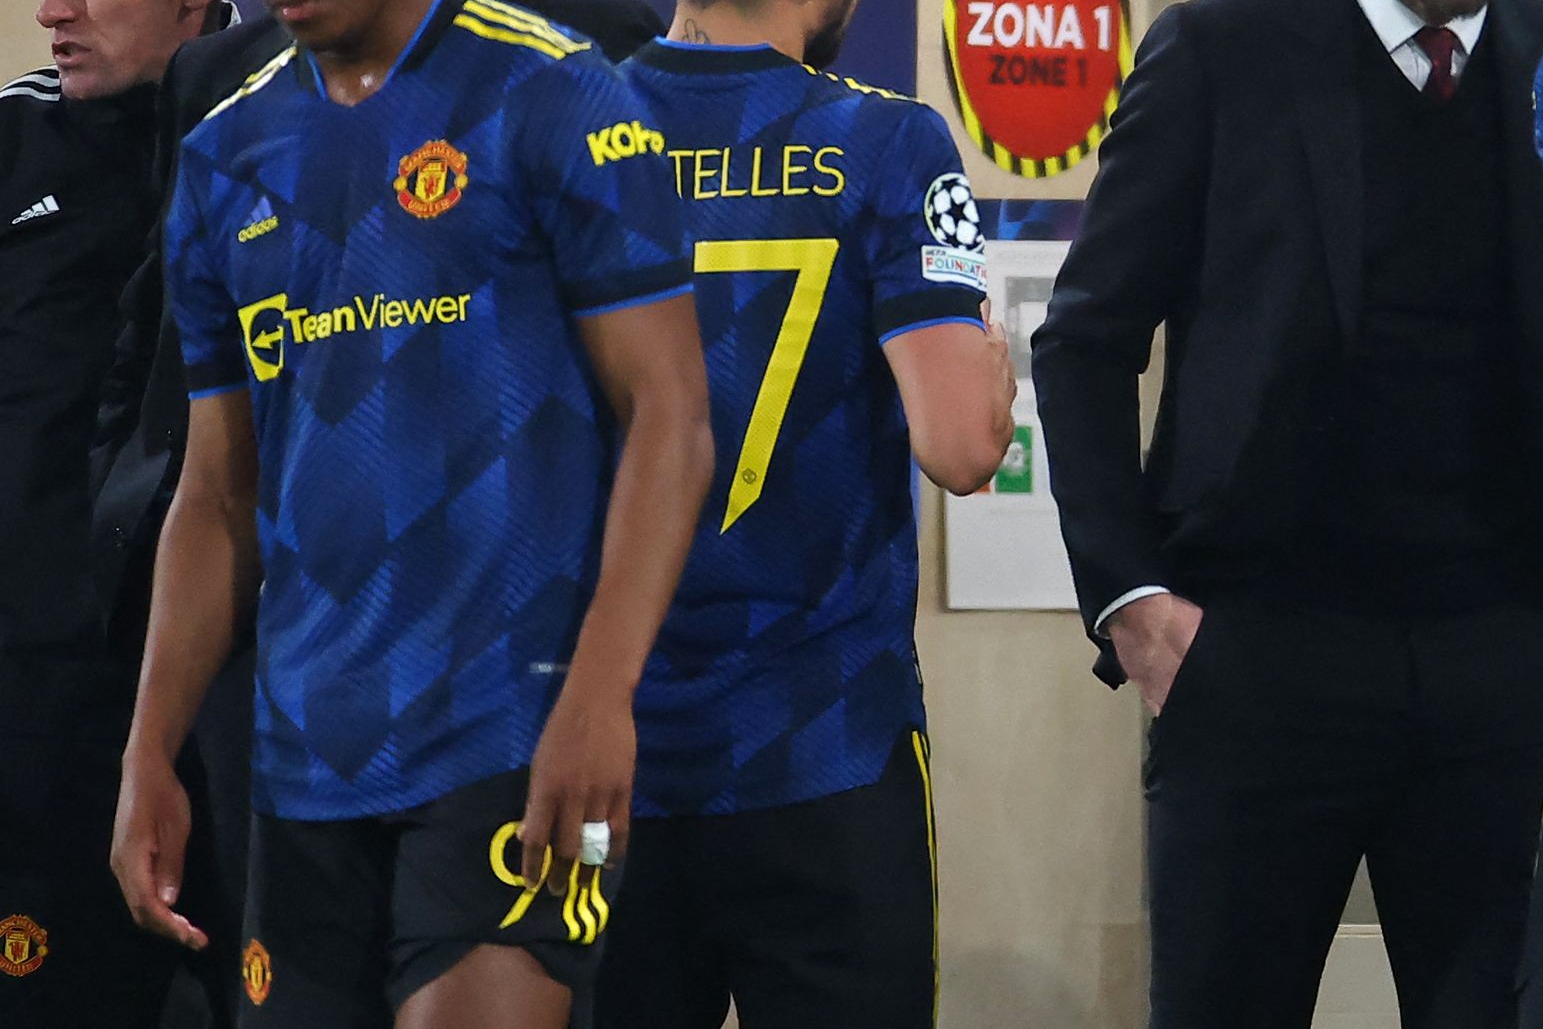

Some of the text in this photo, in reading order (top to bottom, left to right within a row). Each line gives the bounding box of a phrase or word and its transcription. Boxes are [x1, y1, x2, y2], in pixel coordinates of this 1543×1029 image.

[967, 1, 1112, 51] ZONA 1
[989, 54, 1089, 89] ZONE 1
[667, 145, 846, 200] TELLES
[237, 215, 279, 243] adidas
[693, 237, 840, 535] 7
